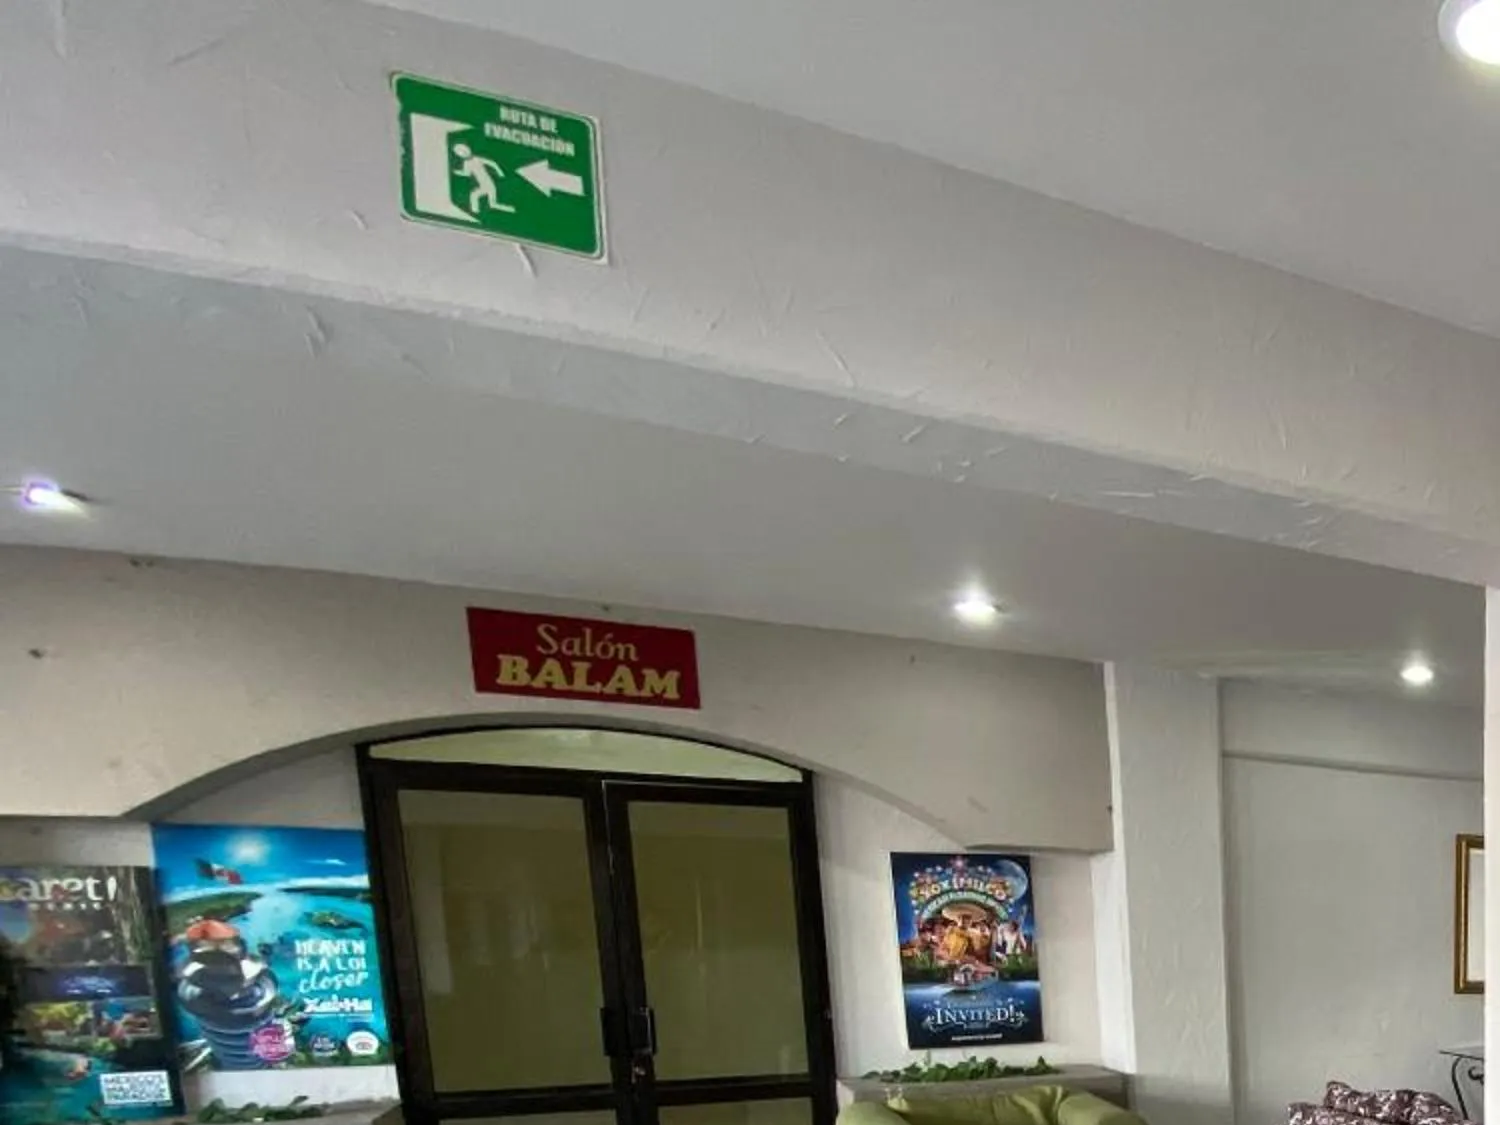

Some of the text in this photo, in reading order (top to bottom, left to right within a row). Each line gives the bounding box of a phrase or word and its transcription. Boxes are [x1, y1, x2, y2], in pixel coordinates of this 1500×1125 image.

[500, 105, 558, 134] RUTA DE
[536, 622, 639, 662] Salón
[496, 654, 681, 699] BALAM
[295, 938, 366, 956] HEAVEN
[320, 957, 331, 973] A
[299, 969, 369, 994] closer
